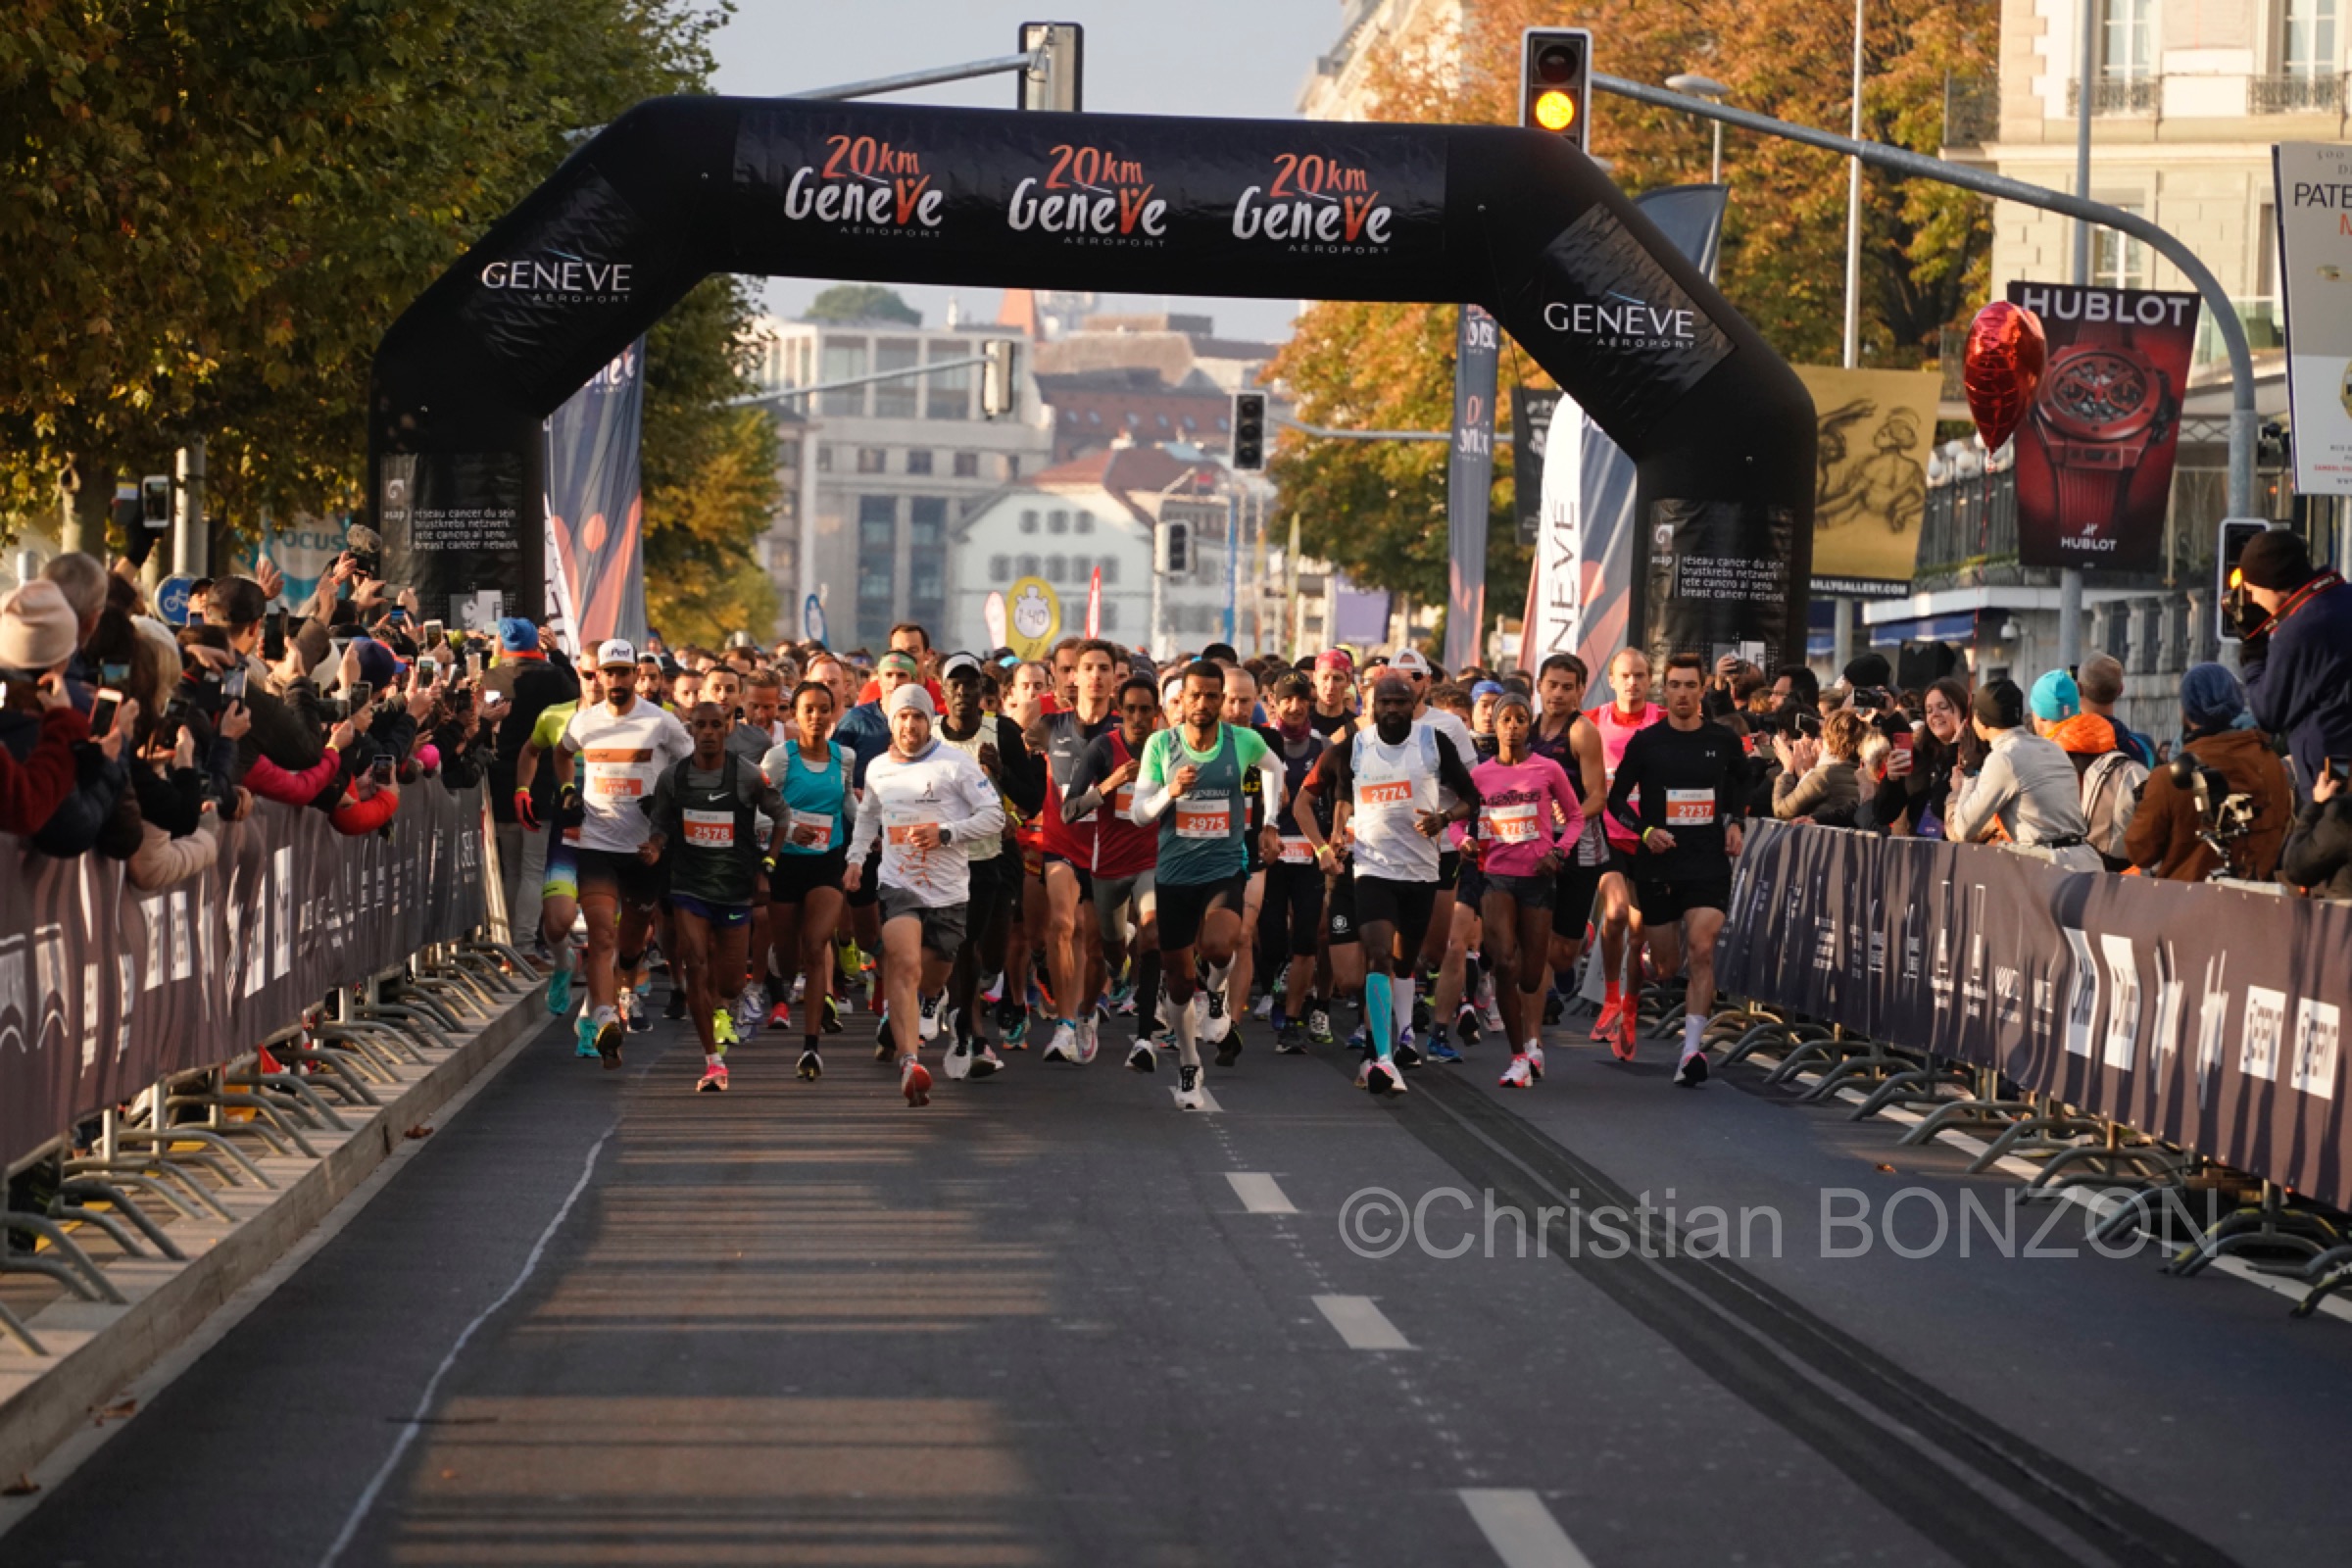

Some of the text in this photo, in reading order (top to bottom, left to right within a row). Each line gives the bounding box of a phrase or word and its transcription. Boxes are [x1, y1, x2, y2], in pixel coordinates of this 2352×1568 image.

[821, 134, 920, 179] 20km
[1046, 144, 1144, 190] 20km
[1270, 153, 1368, 199] 20km
[2024, 287, 2190, 326] HUBLOT
[2061, 537, 2117, 552] HUBLOT
[1371, 786, 1408, 803] 2774
[1678, 805, 1712, 817] 2737
[1188, 816, 1226, 831] 2975
[694, 826, 730, 840] 2578
